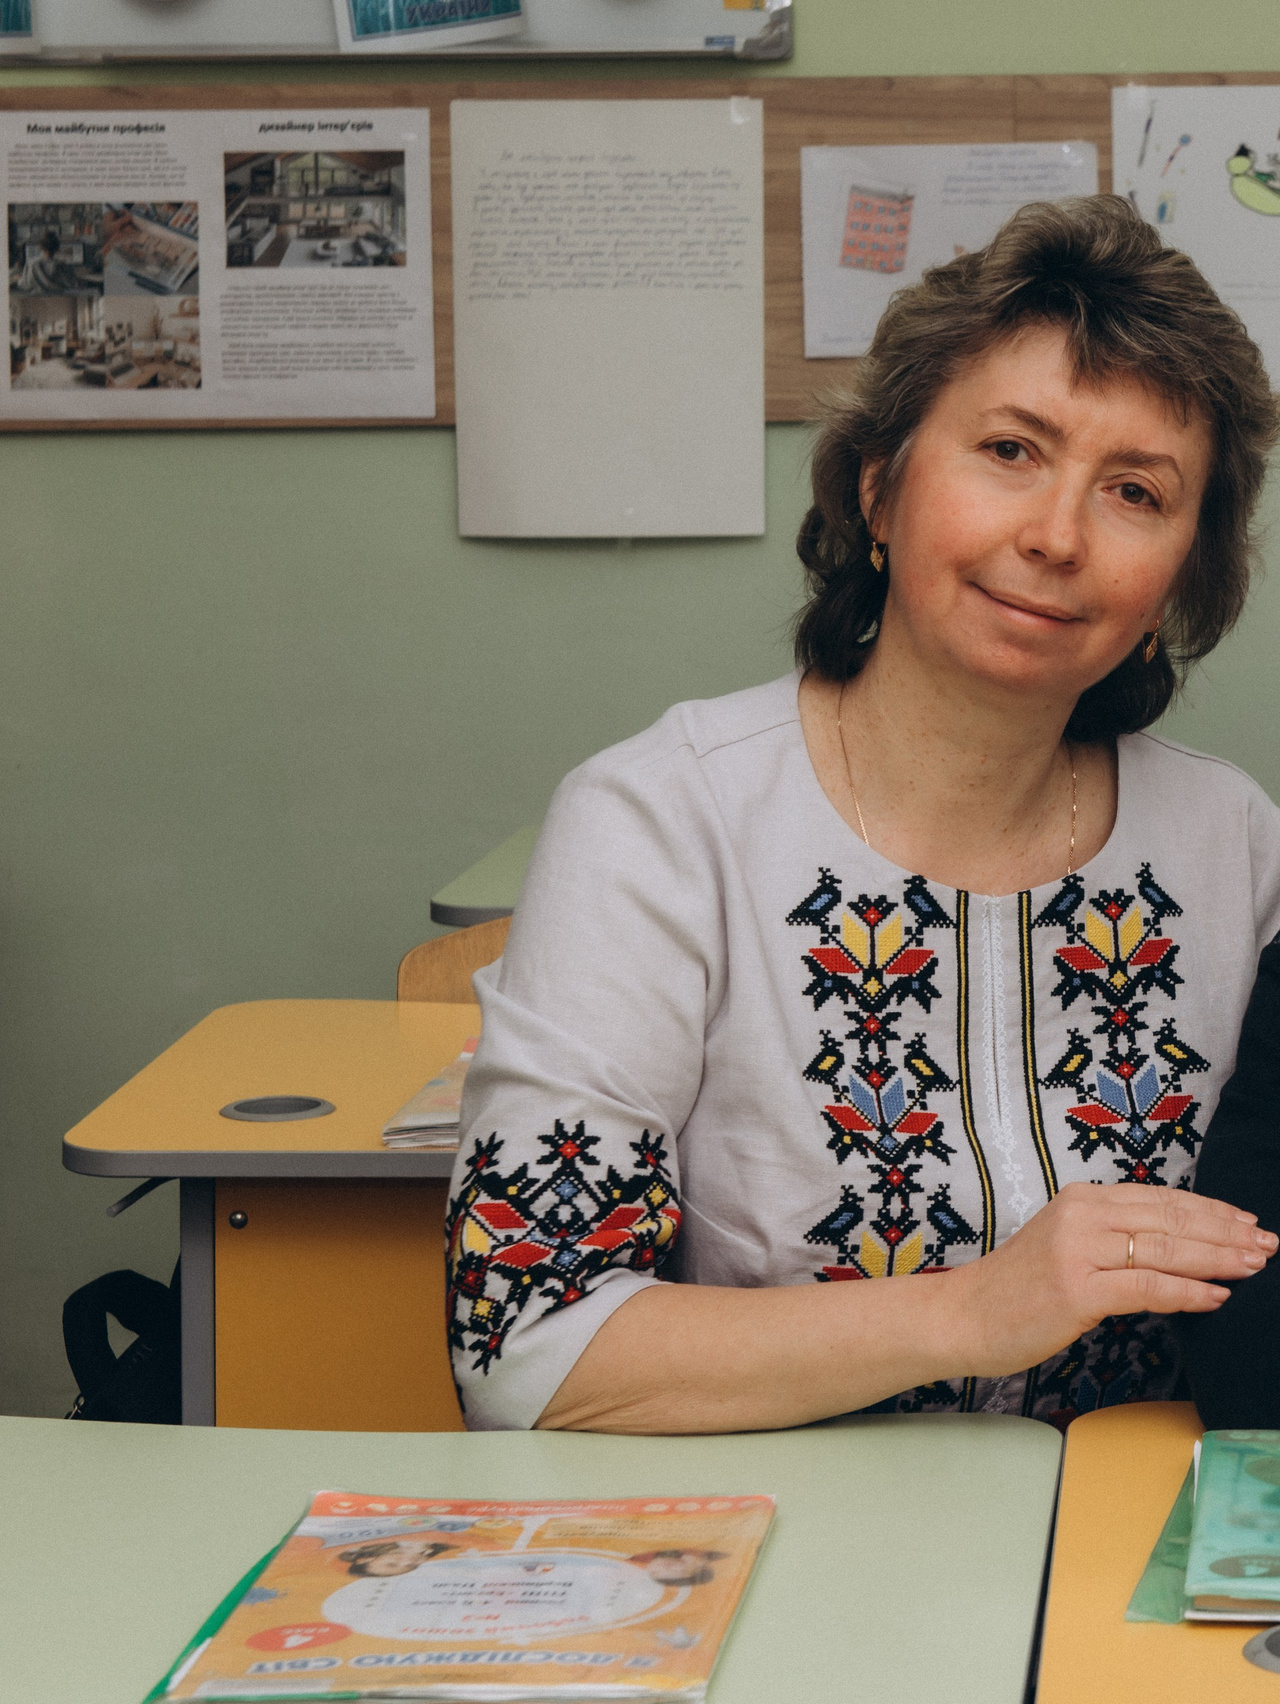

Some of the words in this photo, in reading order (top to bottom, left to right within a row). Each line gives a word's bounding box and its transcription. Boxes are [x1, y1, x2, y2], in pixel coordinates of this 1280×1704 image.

[27, 122, 52, 134] Моя
[55, 122, 109, 136] майбутня
[112, 122, 166, 136] професія
[259, 120, 315, 133] дизайнер
[282, 1633, 315, 1650] 4
[250, 1656, 340, 1674] СВІТ
[351, 1651, 621, 1667] ДОСЛІДЖУЮ
